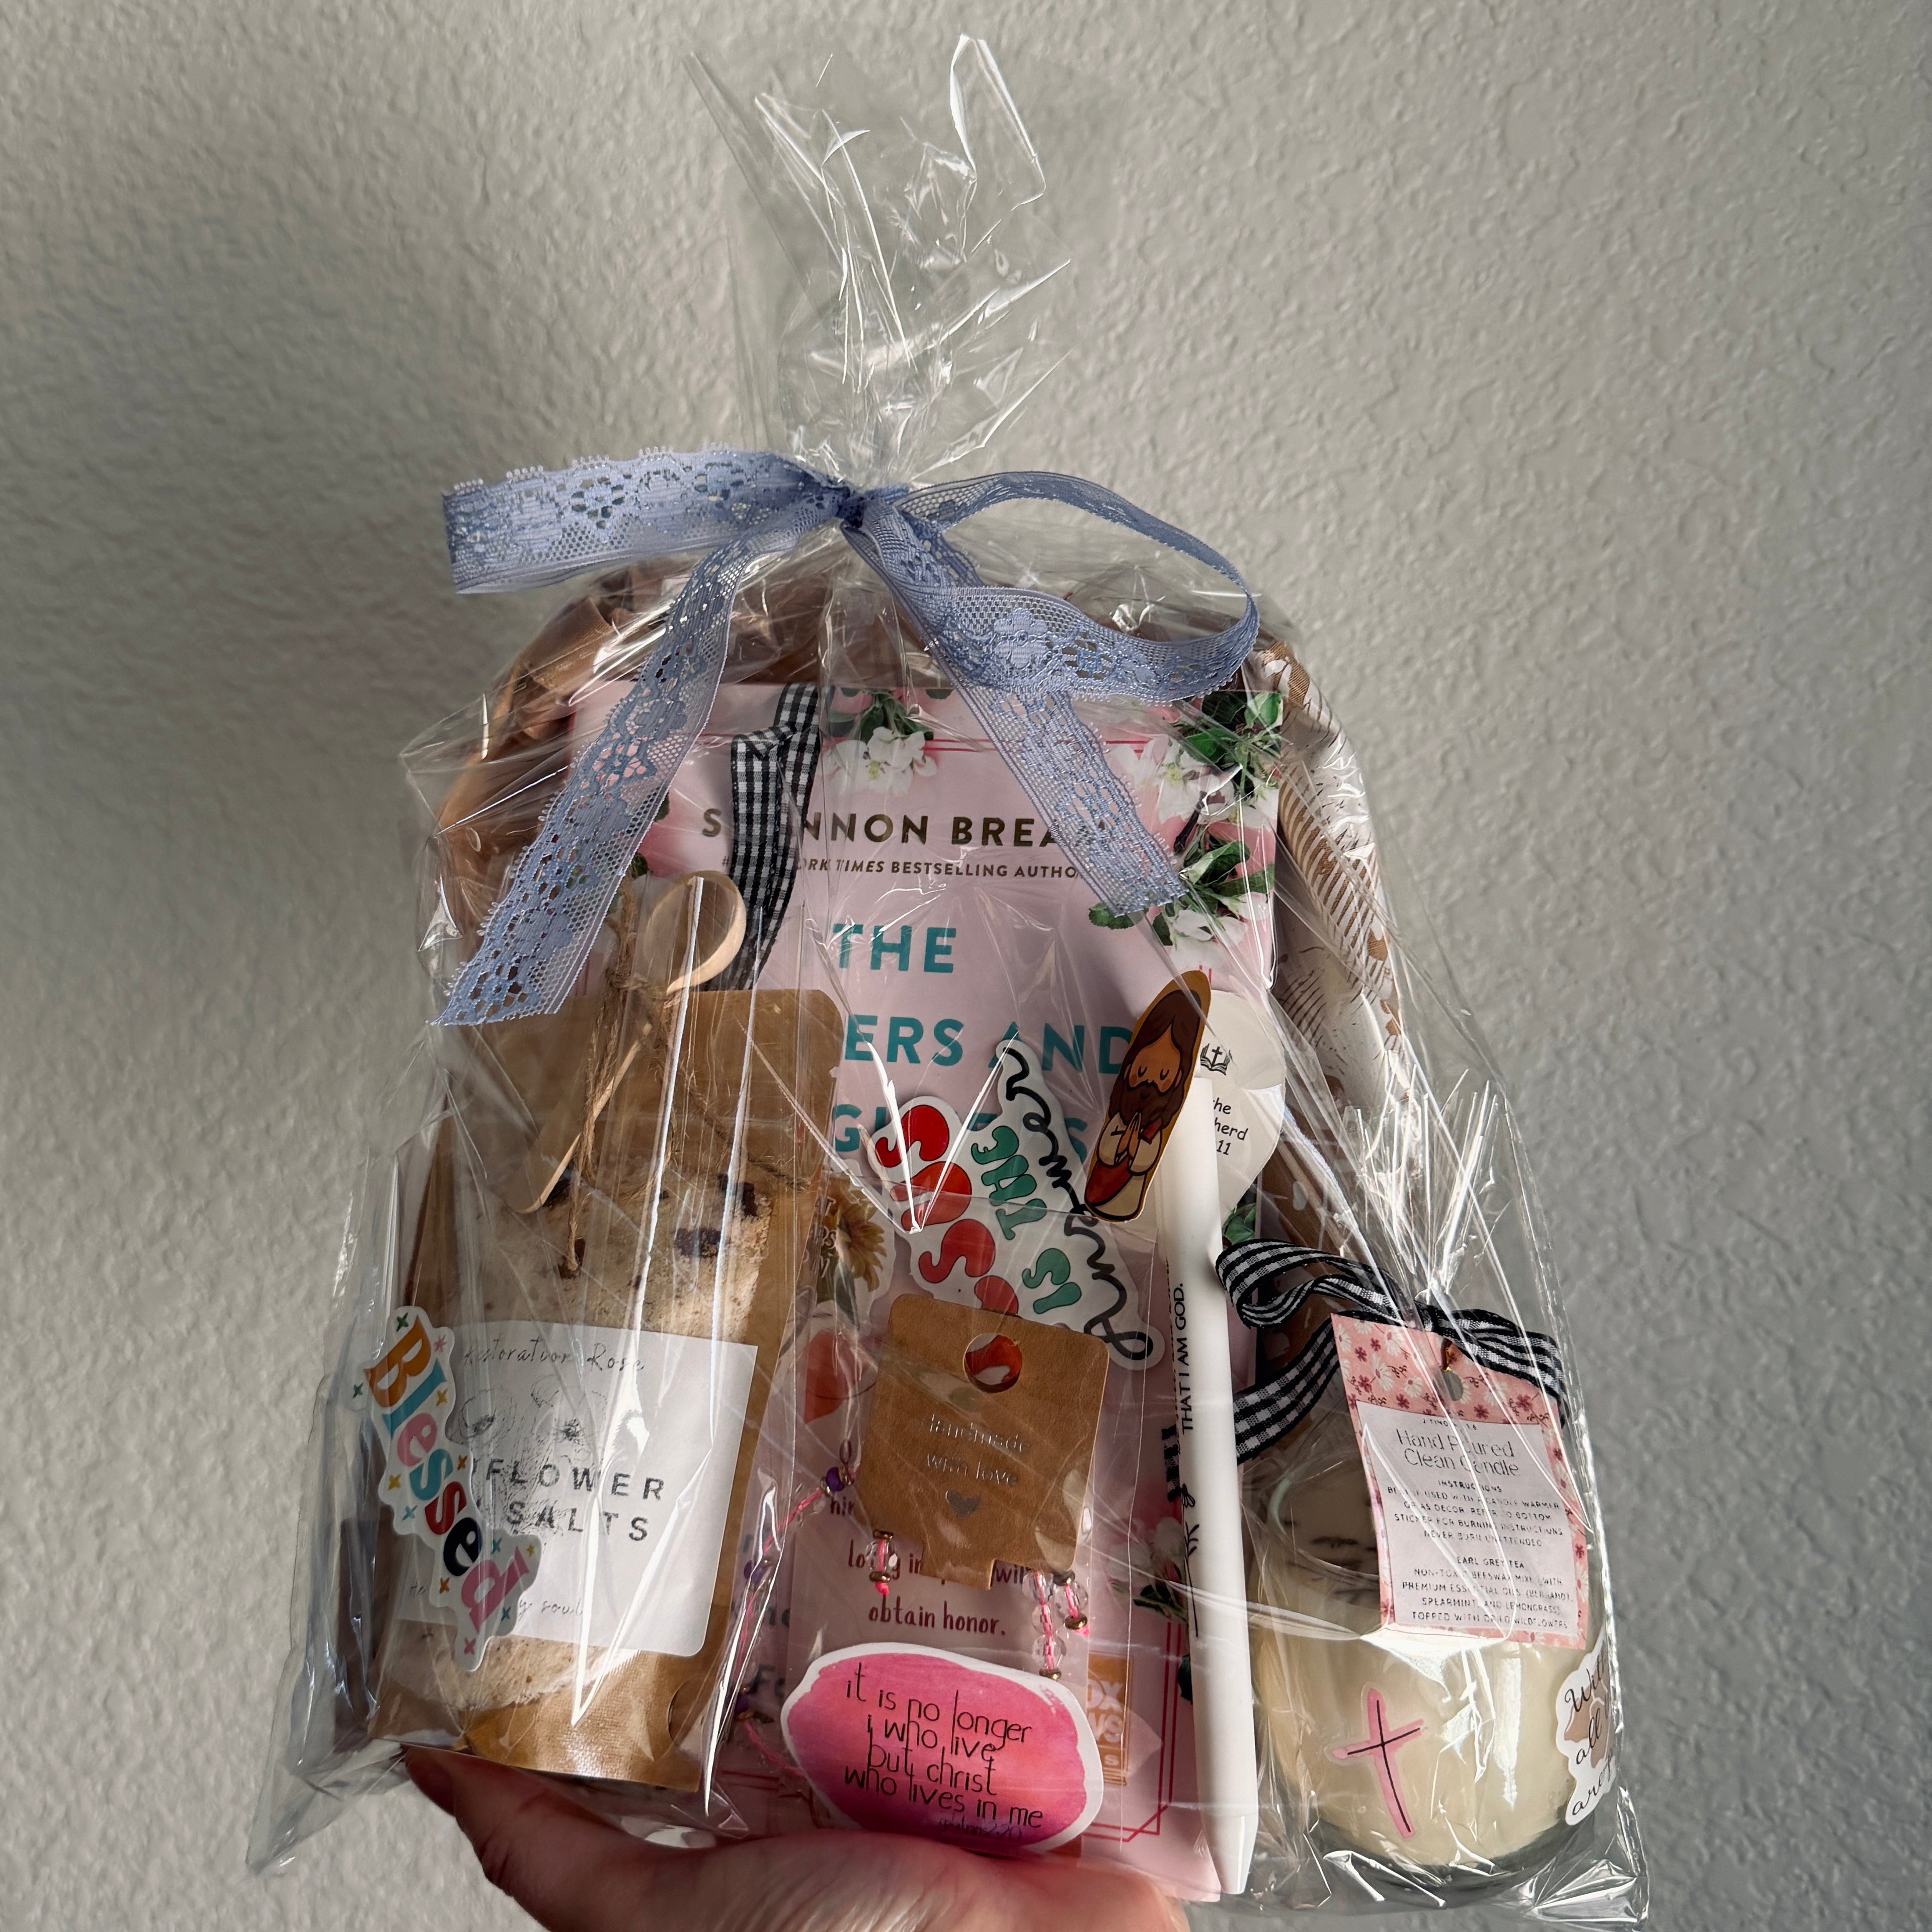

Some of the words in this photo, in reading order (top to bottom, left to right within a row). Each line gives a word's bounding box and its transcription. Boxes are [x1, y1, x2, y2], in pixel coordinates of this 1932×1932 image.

[702, 808, 928, 845] SNNON
[951, 816, 1060, 847] BRE
[800, 858, 829, 871] RK
[836, 859, 884, 872] TIMES
[891, 861, 1007, 876] BESTSELLING
[1014, 865, 1080, 878] AUTHO
[833, 923, 956, 973] THE
[844, 1013, 964, 1066] ERS
[1213, 1097, 1232, 1114] he
[1214, 1117, 1249, 1141] herd
[1216, 1140, 1231, 1155] 11
[970, 1125, 1048, 1241] THE
[1002, 1046, 1154, 1360] Answer
[1022, 1248, 1082, 1314] IS
[1173, 1283, 1186, 1331] GOD.
[587, 1342, 646, 1372] Rose
[1176, 1337, 1189, 1366] AM
[1178, 1381, 1193, 1434] THAT
[1396, 1428, 1444, 1451] Hand
[363, 1314, 530, 1634] Blessed
[976, 1461, 1018, 1486] love
[1404, 1448, 1456, 1470] Clean
[1460, 1454, 1519, 1476] Candle
[486, 1458, 665, 1501] FLOWER
[1437, 1480, 1502, 1493] INSTRUCIONS
[1424, 1490, 1448, 1500] USED
[1521, 1500, 1560, 1510] WARMER
[1471, 1507, 1497, 1516] REFR
[1515, 1511, 1551, 1521] BOTTOM
[507, 1499, 649, 1542] SALTS
[1394, 1513, 1432, 1523] STICKER
[1436, 1517, 1455, 1526] FOR
[1458, 1519, 1497, 1531] BURNIN
[1423, 1530, 1453, 1540] NEVER
[1458, 1532, 1482, 1542] BURN
[996, 1564, 1030, 1584] wil
[1414, 1567, 1468, 1579] NON-TOXC
[1471, 1571, 1511, 1581] BEESWAX
[1515, 1574, 1542, 1585] MIXE
[1543, 1577, 1563, 1586] WITH
[1457, 1556, 1479, 1566] EARL
[1483, 1558, 1504, 1567] GREY
[1508, 1560, 1525, 1569] TEA
[1402, 1581, 1446, 1591] PREMIUM
[1451, 1584, 1498, 1594] ESSNTIAL
[541, 1597, 584, 1616] soul
[868, 1594, 935, 1629] obtain
[942, 1600, 1006, 1636] honor.
[1412, 1611, 1450, 1621] TOPPED
[1454, 1613, 1480, 1622] WITH
[1484, 1600, 1501, 1608] AND
[846, 1662, 867, 1702] it
[878, 1689, 897, 1711] is
[907, 1698, 940, 1722] no
[952, 1689, 1032, 1750] longer
[867, 1714, 872, 1733] i
[884, 1718, 938, 1748] who
[950, 1731, 996, 1761] live
[1575, 1707, 1602, 1765] all
[926, 1746, 997, 1796] christ
[845, 1765, 897, 1795] who
[909, 1763, 965, 1812] lives
[976, 1799, 997, 1821] in
[1009, 1805, 1043, 1828] me
